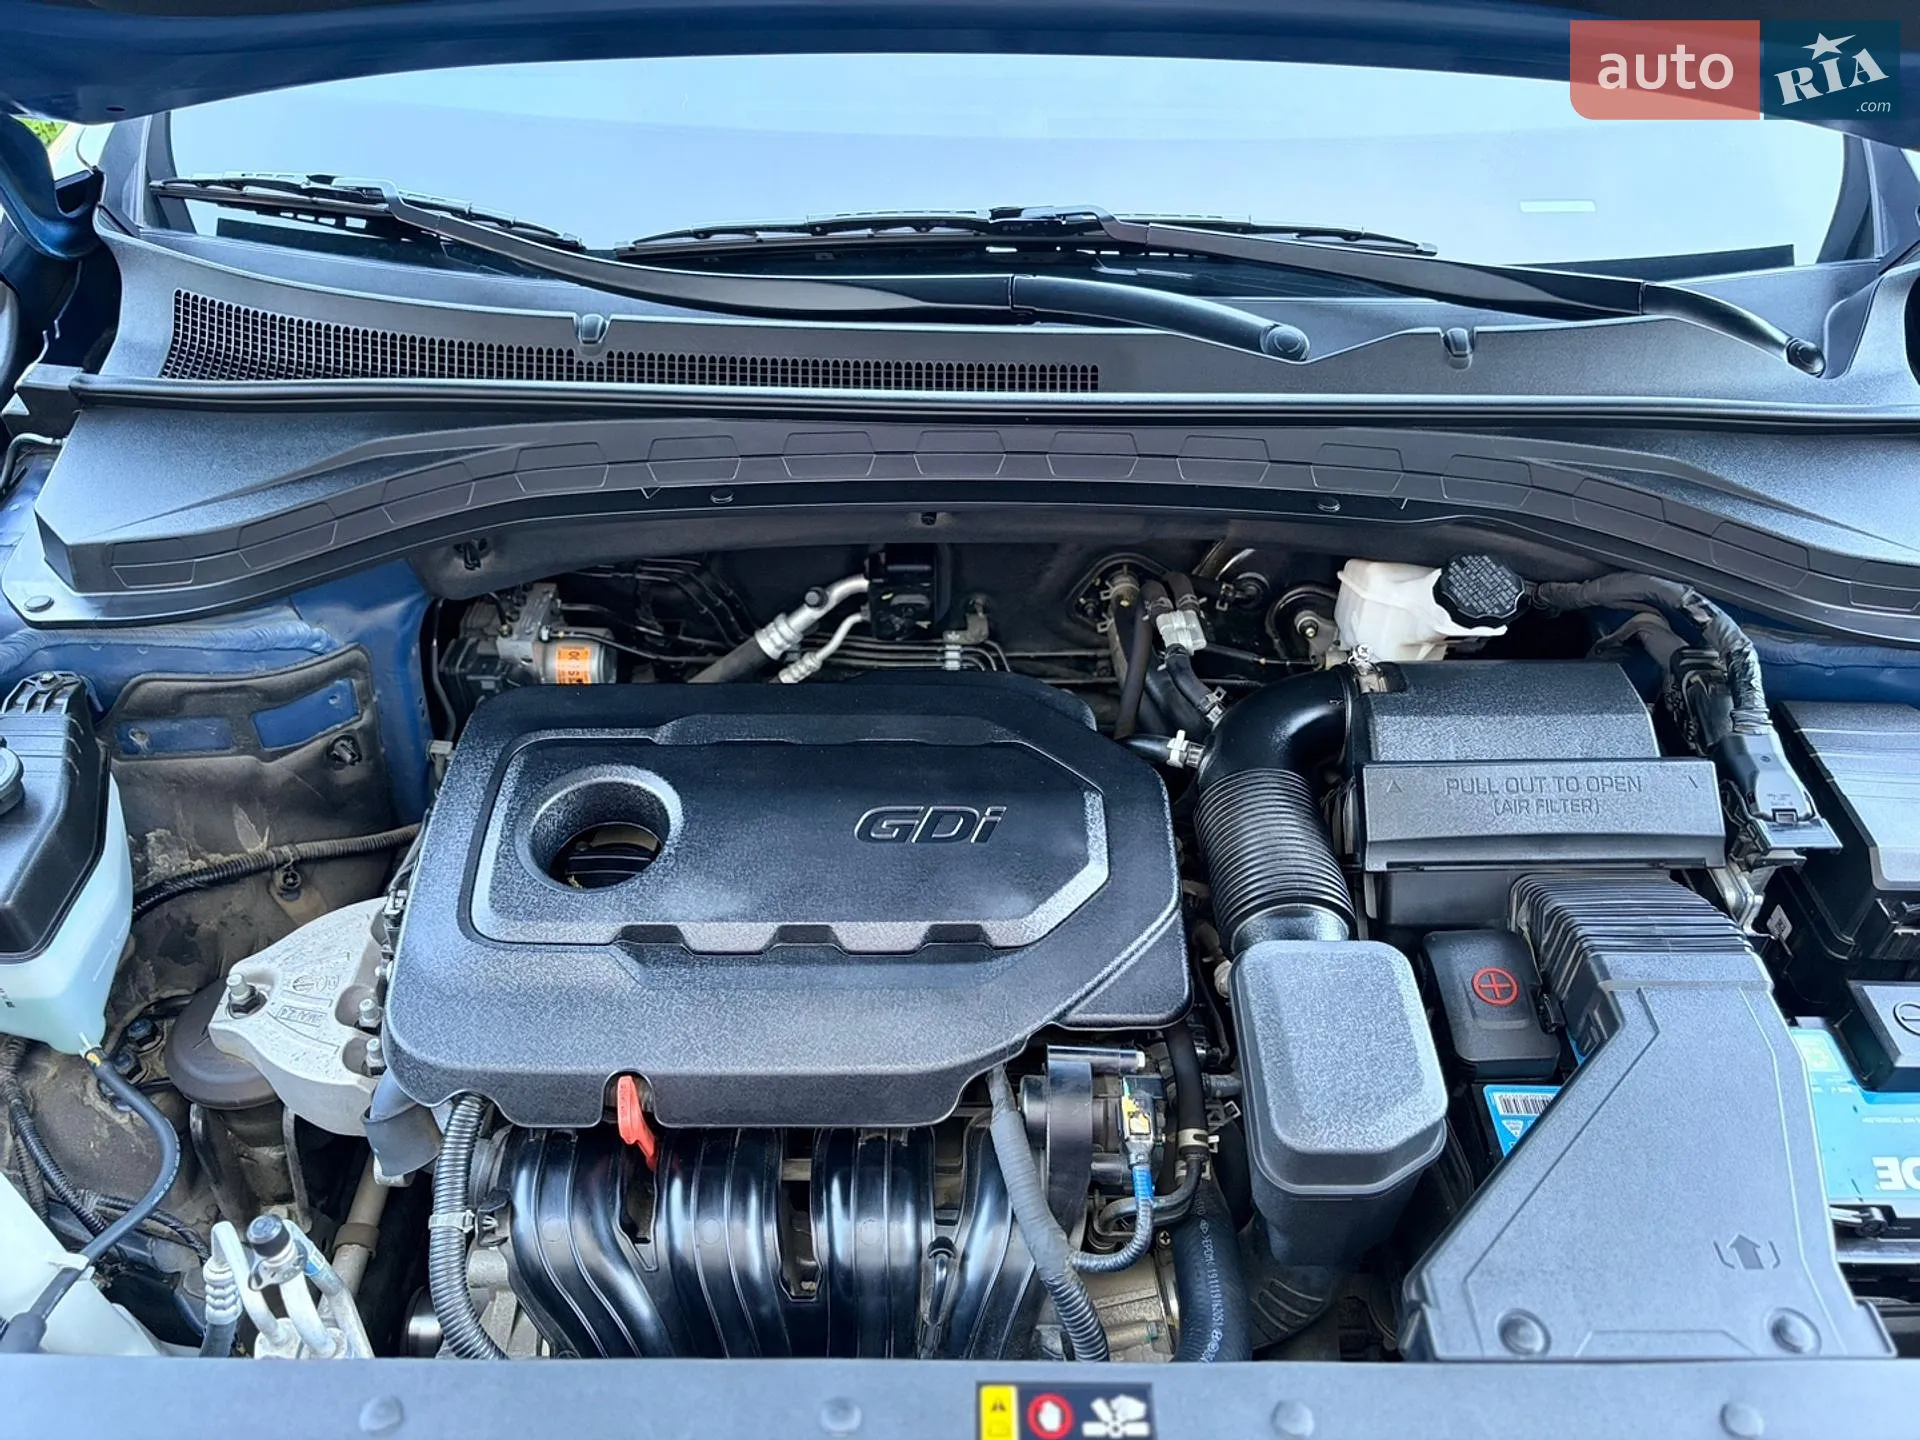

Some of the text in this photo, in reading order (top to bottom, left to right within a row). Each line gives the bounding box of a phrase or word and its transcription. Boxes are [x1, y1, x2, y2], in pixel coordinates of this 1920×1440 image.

[1446, 775, 1643, 796] PULL OUT TO OPEN
[1493, 798, 1600, 816] (AIR FILTER)
[854, 805, 1007, 844] GDi
